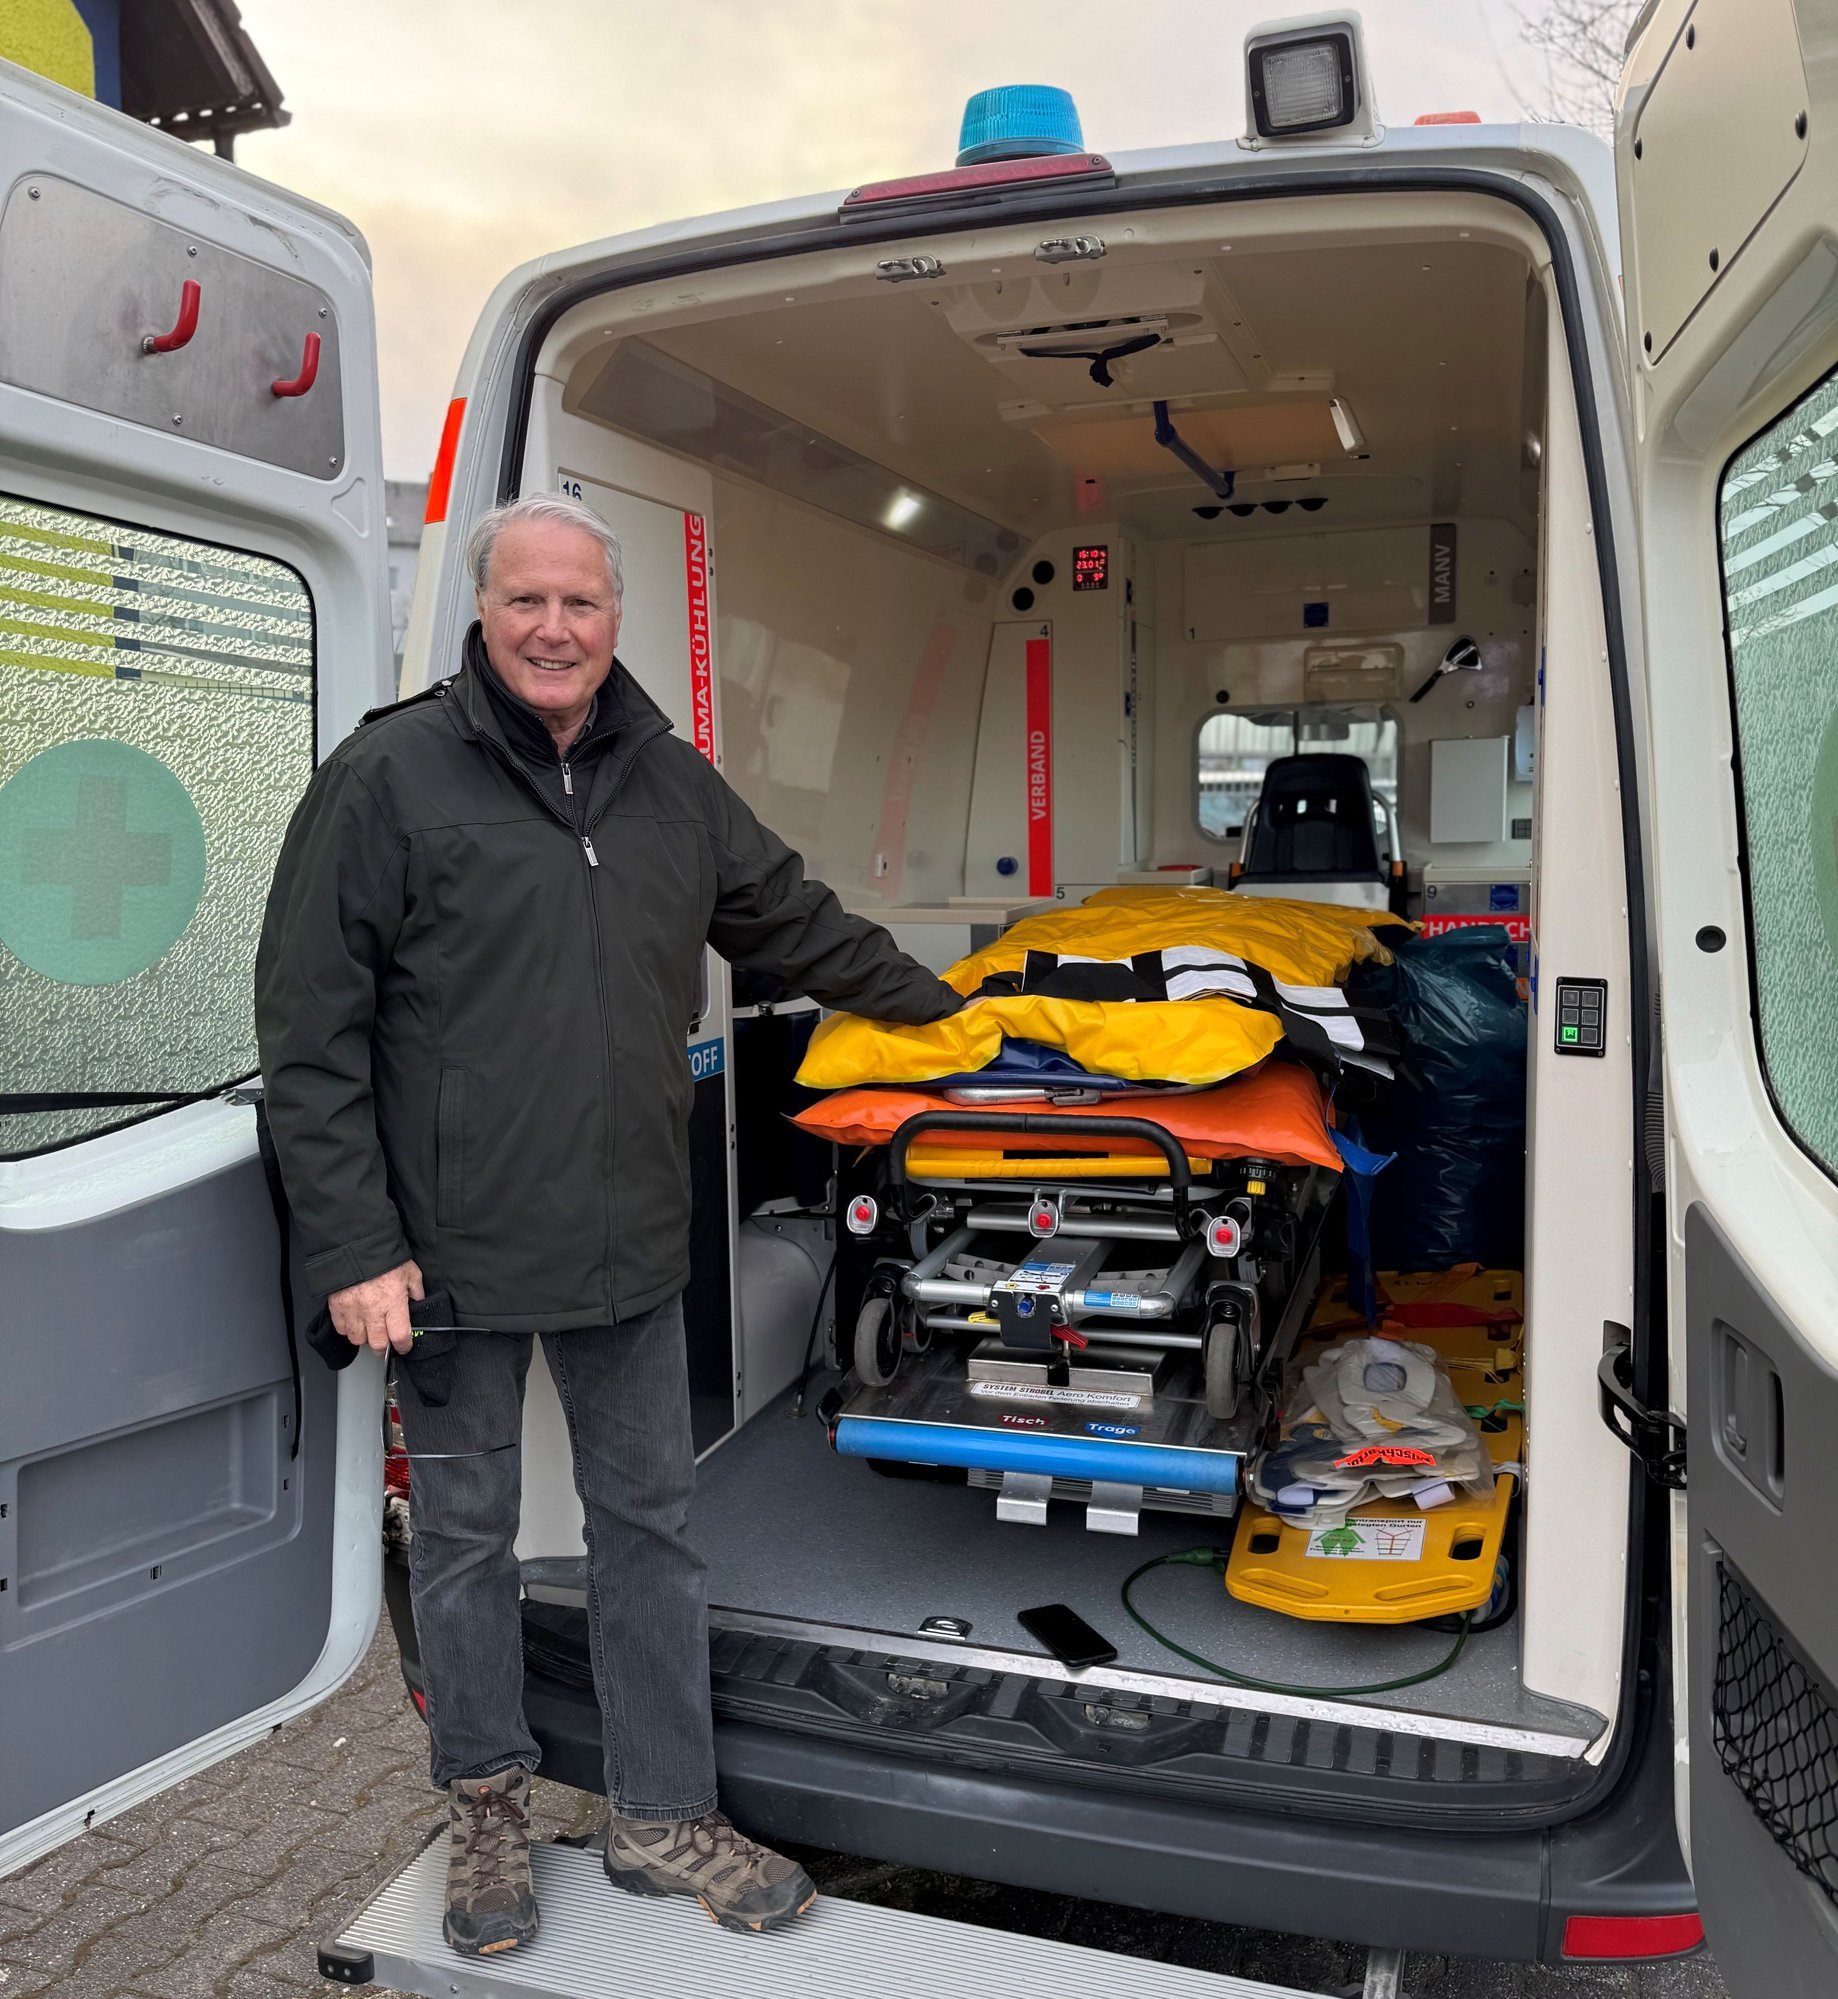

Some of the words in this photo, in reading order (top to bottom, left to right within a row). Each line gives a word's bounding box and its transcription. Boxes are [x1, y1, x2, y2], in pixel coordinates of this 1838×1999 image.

[563, 480, 582, 501] 16
[1433, 544, 1451, 604] MANV
[1040, 625, 1049, 638] 4
[1188, 627, 1195, 640] 1
[1030, 731, 1046, 821] VERBAND
[1056, 886, 1065, 900] 5
[1427, 885, 1437, 899] 9
[688, 1046, 718, 1076] OFF
[983, 1383, 1017, 1392] SYSTEM
[1019, 1387, 1054, 1396] STROBEL
[1057, 1390, 1084, 1398] Aero
[1087, 1393, 1131, 1402] Komfort
[1002, 1415, 1045, 1426] Tisch
[1089, 1423, 1136, 1435] Trage
